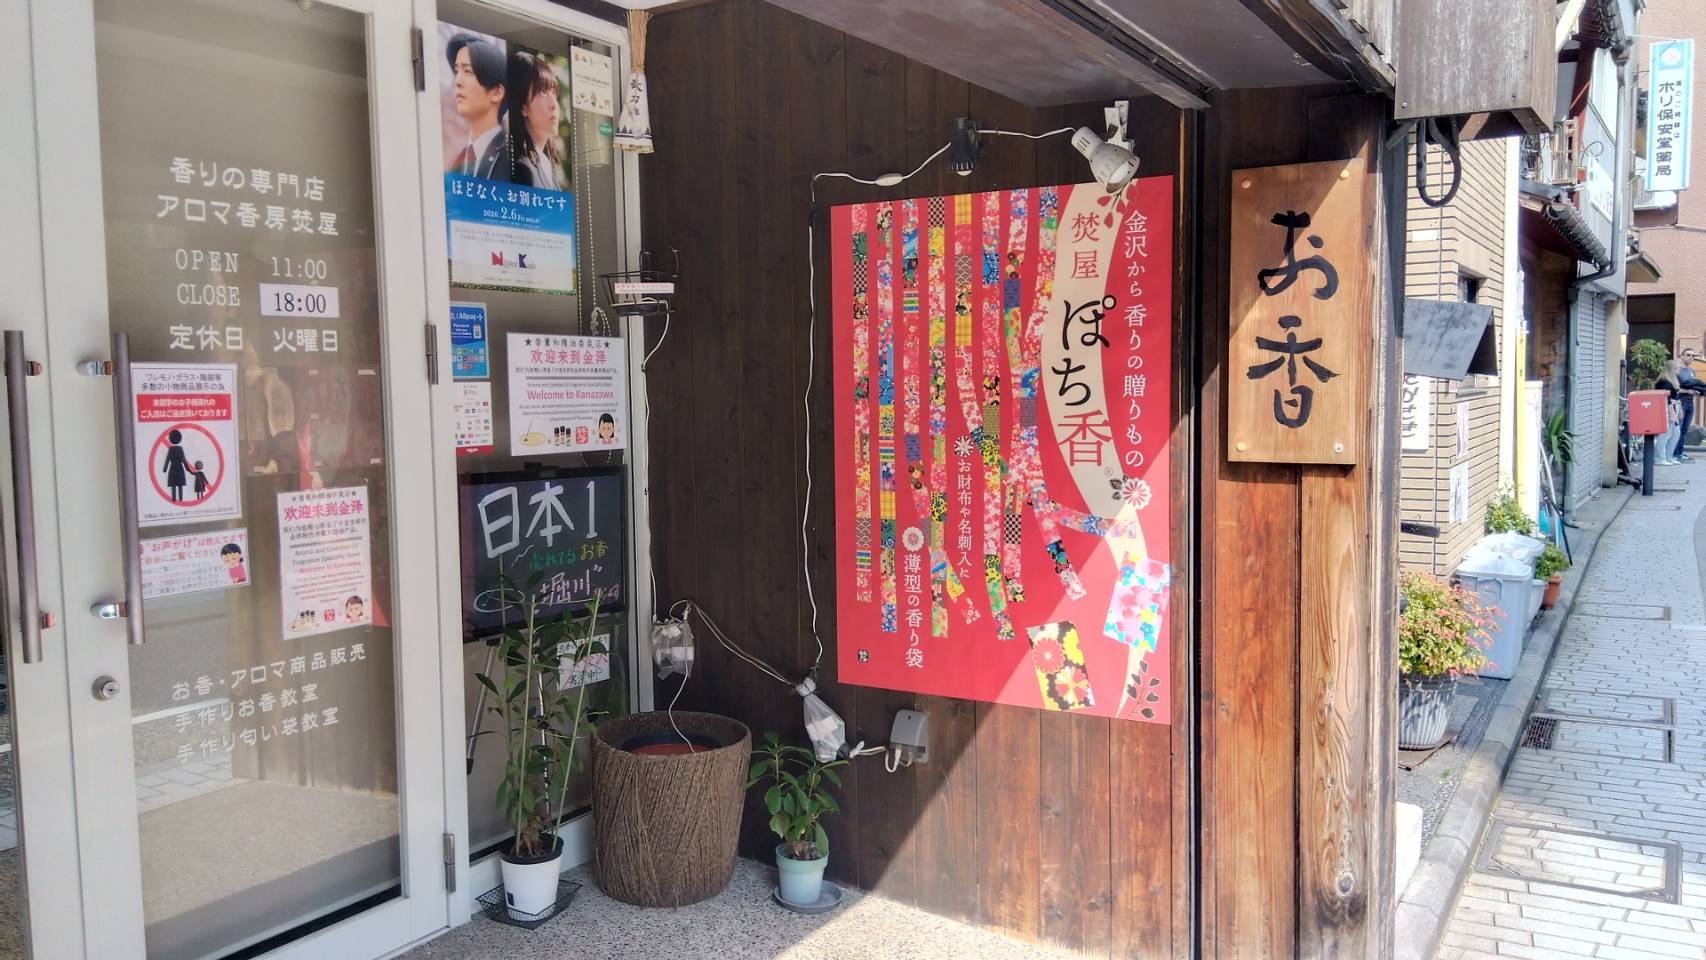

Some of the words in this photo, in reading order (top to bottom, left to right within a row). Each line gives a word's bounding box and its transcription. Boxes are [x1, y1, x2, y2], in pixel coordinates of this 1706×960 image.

[1655, 81, 1675, 177] ホリ保安堂薬局
[170, 156, 325, 201] 香りの専門店
[452, 180, 567, 211] ほどなく、お別れです
[157, 194, 339, 235] アロマ香房焚屋
[175, 249, 239, 273] OPEN
[272, 256, 327, 280] 11:00
[1070, 212, 1100, 280] 焚屋
[176, 283, 240, 306] CLOSE
[273, 292, 326, 313] 18:00
[1246, 210, 1342, 428] お香
[169, 323, 243, 350] 定休日
[273, 327, 338, 352] 火曜日
[530, 349, 606, 365] 欢迎来到金泽
[1122, 209, 1149, 467] 金沢から香りの贈りもの
[527, 390, 565, 400] Welcome
[566, 391, 574, 399] to
[576, 390, 615, 400] Kanazawa
[284, 500, 363, 521] 欢迎来到金泽
[957, 460, 973, 579] お財布や名刺入に
[580, 540, 608, 561] お香
[903, 554, 924, 669] 薄型の香り袋
[172, 643, 366, 701] お香・アロマ商品販売
[175, 683, 318, 733] 手作りお香教室
[177, 707, 339, 764] 手作り匂い袋教室
